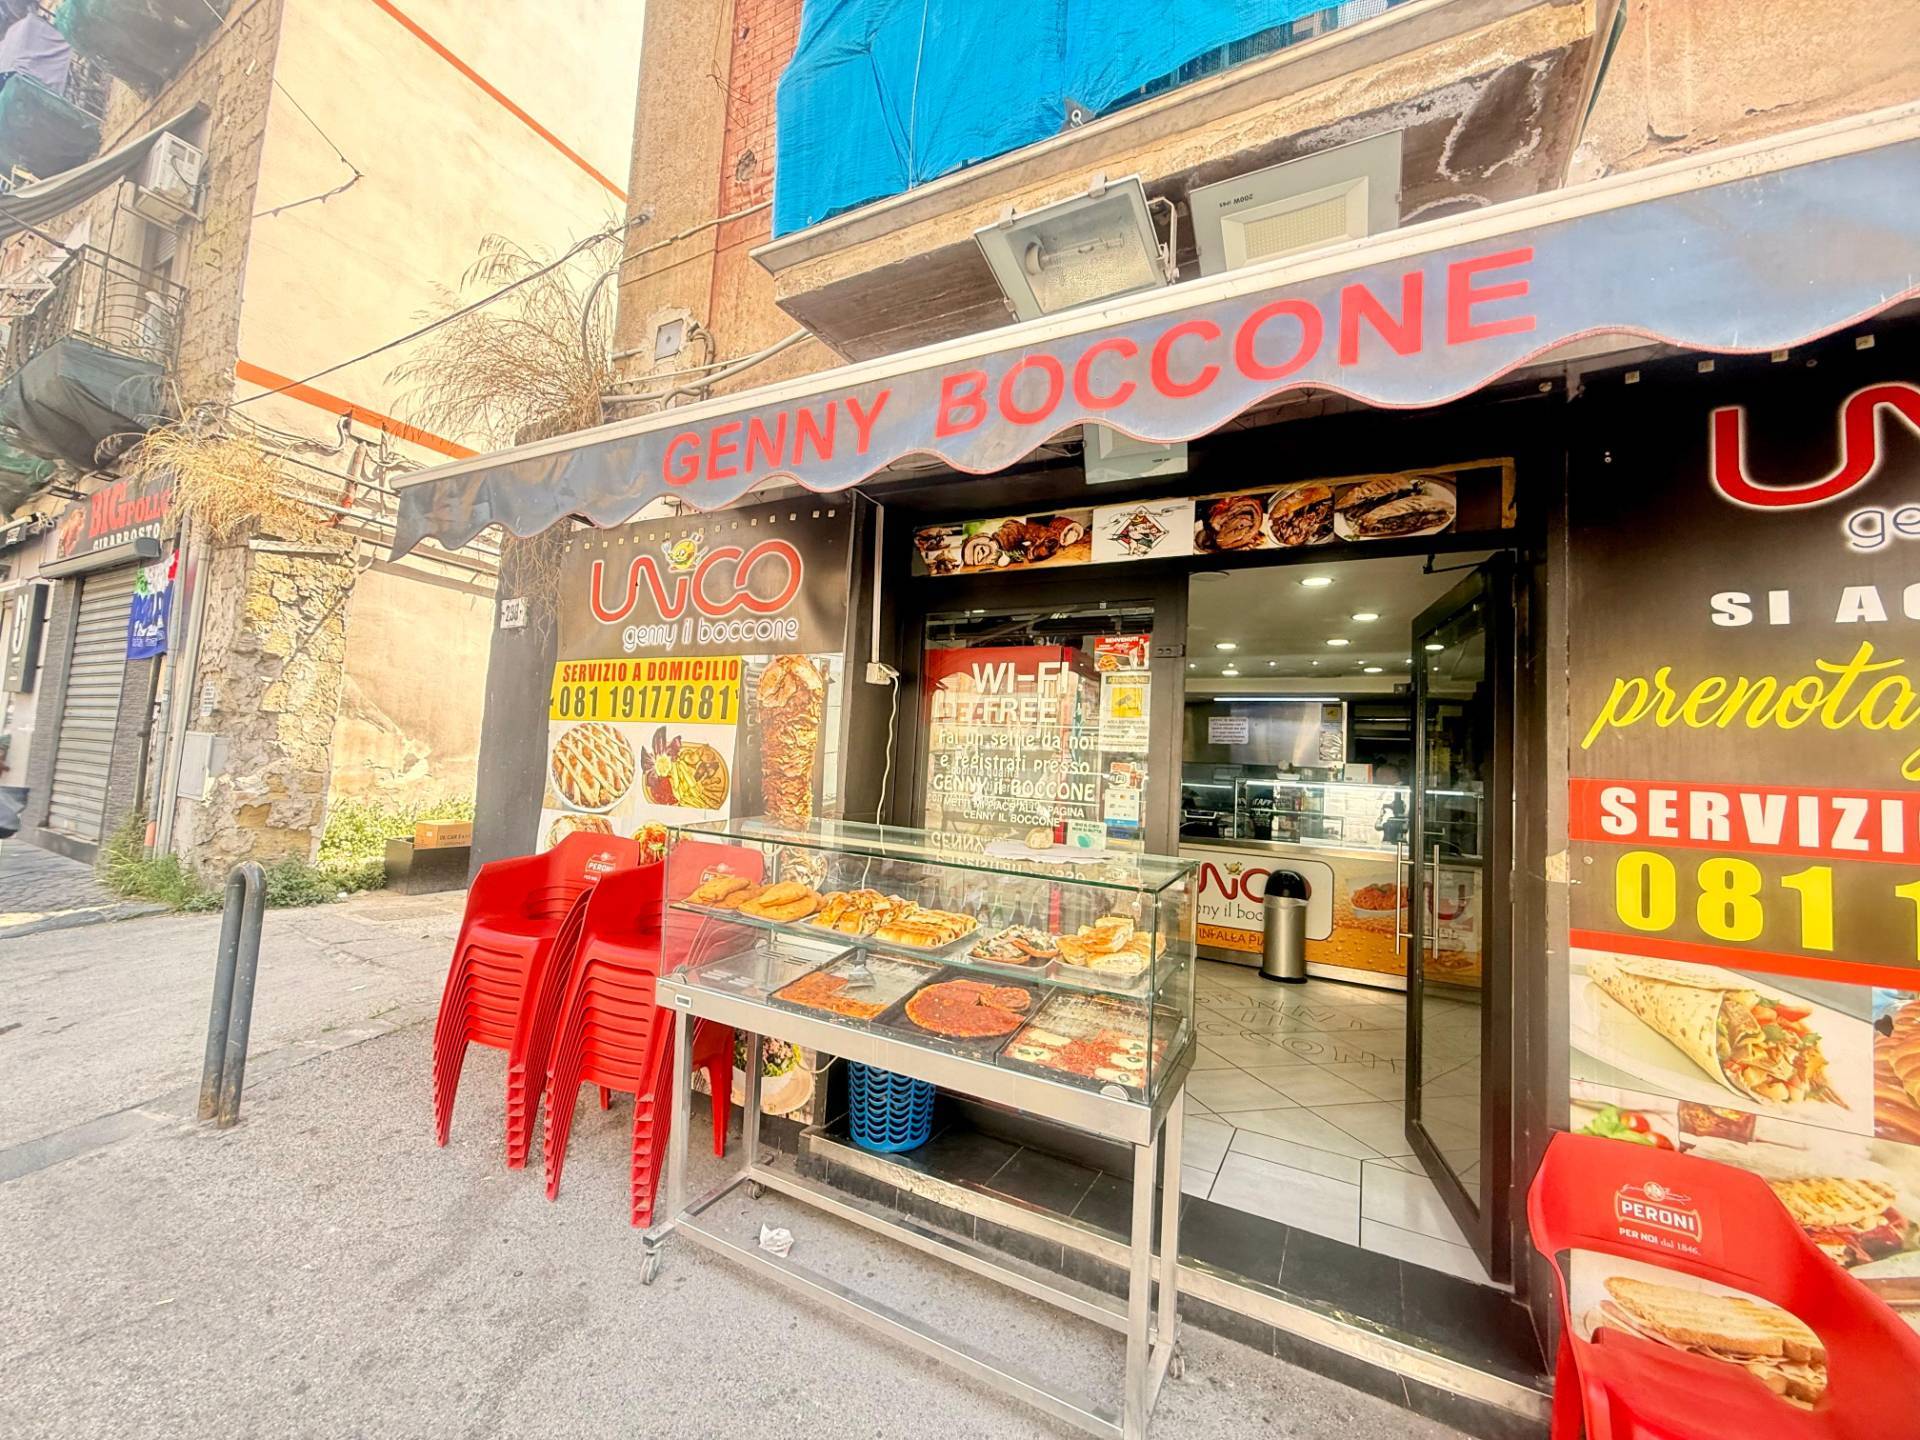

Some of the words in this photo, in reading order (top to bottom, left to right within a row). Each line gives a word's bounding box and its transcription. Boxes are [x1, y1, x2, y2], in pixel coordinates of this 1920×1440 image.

[662, 388, 894, 488] GENNY
[934, 247, 1537, 439] BOCCONE
[591, 538, 804, 624] UNICO
[1710, 590, 1791, 627] SI
[623, 623, 676, 652] genny
[682, 619, 692, 644] il
[699, 618, 799, 643] boccone
[562, 662, 627, 683] SERVIZIO
[632, 662, 642, 682] A
[647, 659, 738, 682] DOMICILIO
[972, 661, 1070, 694] WI-FI
[559, 688, 598, 718] 081
[610, 684, 729, 721] 19177681
[983, 697, 1058, 723] FREE
[1042, 732, 1061, 749] da
[1069, 733, 1095, 750] noi
[940, 754, 949, 767] e
[955, 752, 1027, 771] registrati
[1034, 760, 1090, 774] presso
[933, 774, 987, 793] GENNY
[1011, 779, 1096, 801] BOCCONE
[998, 812, 1007, 823] IL
[1010, 813, 1061, 828] BOCCONE
[1048, 806, 1084, 818] PAGINA
[1600, 787, 1920, 854] SERVIZI
[1224, 901, 1232, 917] il
[1615, 851, 1834, 951] 081
[1621, 1200, 1695, 1232] PERONI
[1619, 1227, 1639, 1239] PER
[1641, 1232, 1659, 1245] NOI
